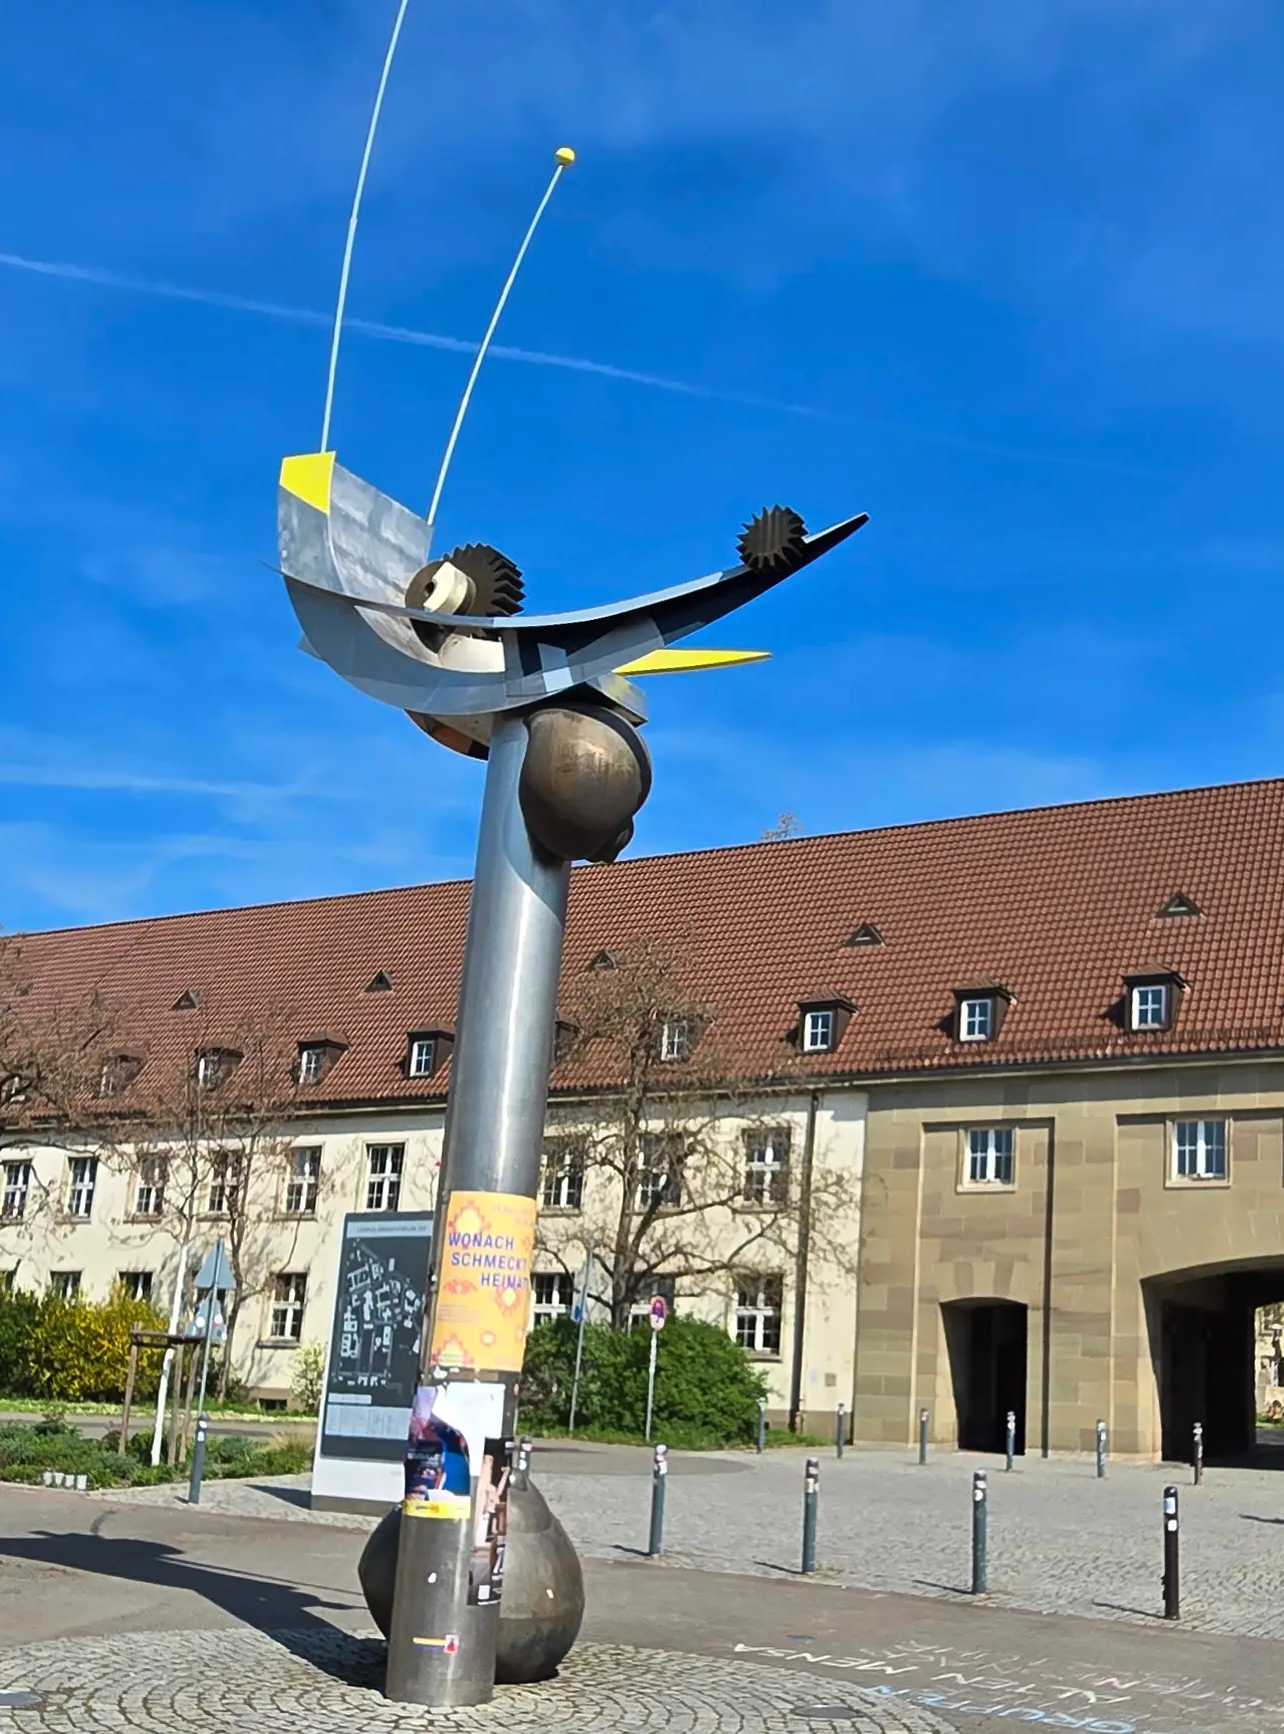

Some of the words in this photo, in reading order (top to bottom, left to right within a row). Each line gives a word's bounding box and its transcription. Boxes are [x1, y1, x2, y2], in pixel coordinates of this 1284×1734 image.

[449, 1231, 514, 1250] WONACH
[451, 1252, 527, 1271] SCHMECKT
[733, 1643, 920, 1675] MENSA
[930, 1672, 1132, 1704] ALTEN
